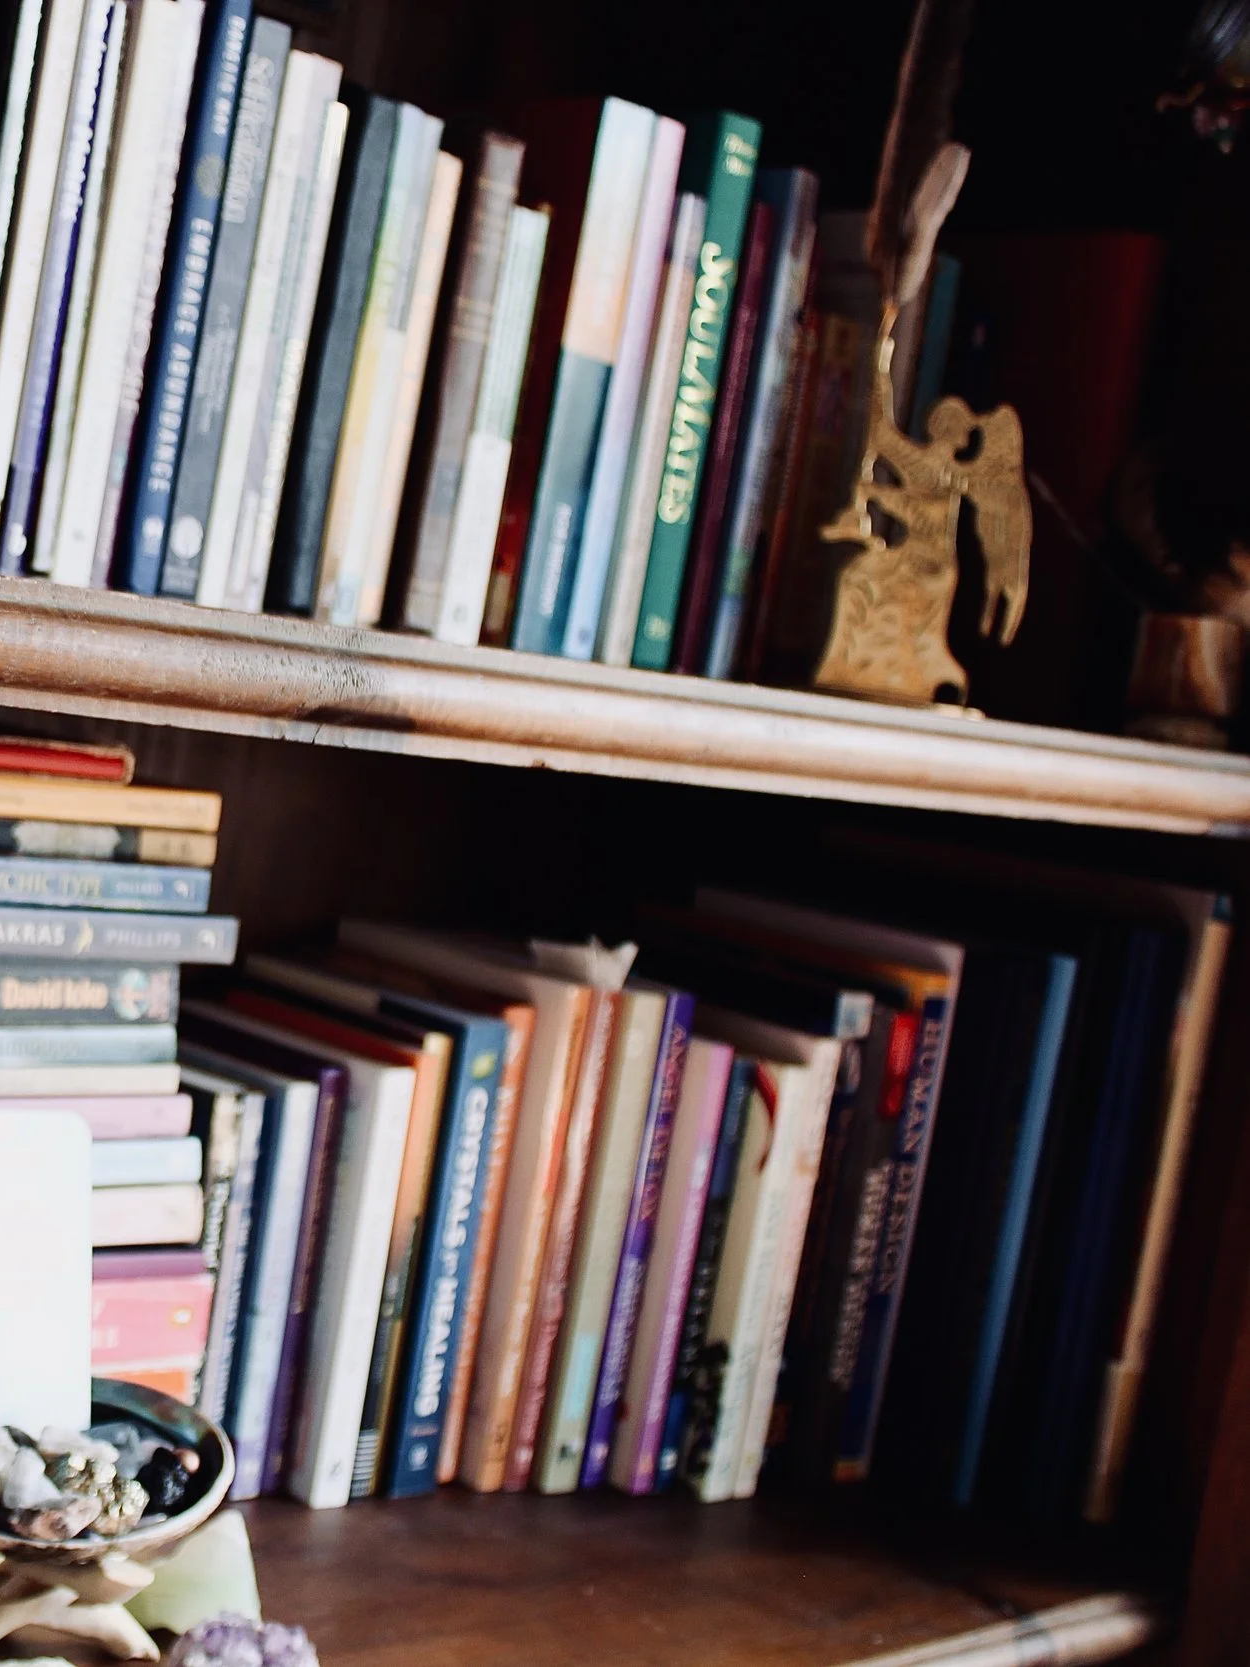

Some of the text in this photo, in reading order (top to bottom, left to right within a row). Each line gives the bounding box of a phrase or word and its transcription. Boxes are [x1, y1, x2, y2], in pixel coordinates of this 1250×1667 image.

[0, 975, 63, 1010] David
[441, 1084, 489, 1246] CRYSTALS
[876, 1016, 943, 1297] HUMAN DESIGN
[413, 1275, 459, 1418] HEALING
